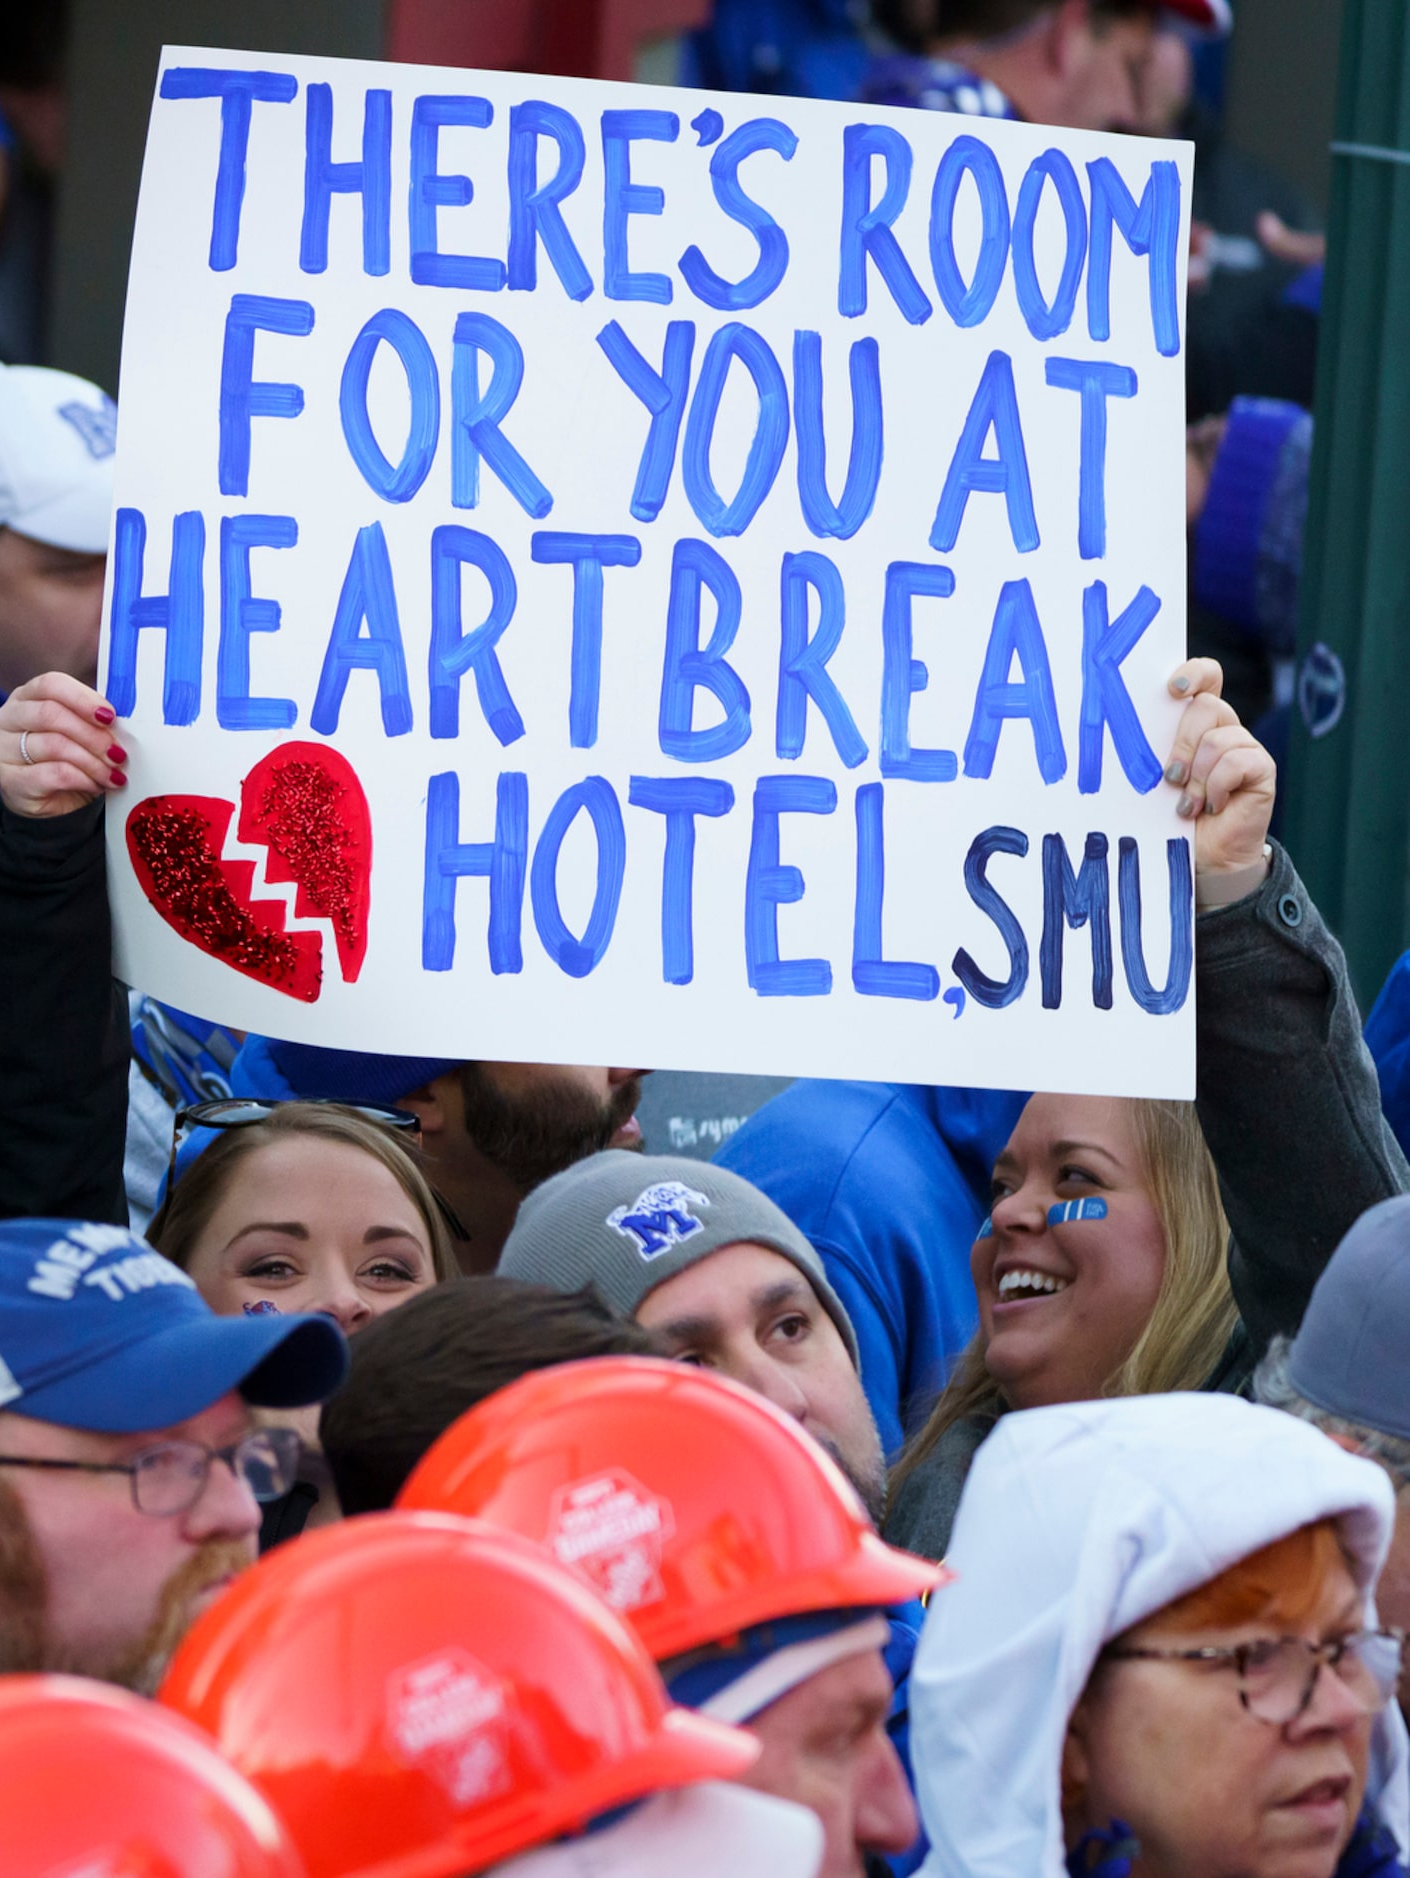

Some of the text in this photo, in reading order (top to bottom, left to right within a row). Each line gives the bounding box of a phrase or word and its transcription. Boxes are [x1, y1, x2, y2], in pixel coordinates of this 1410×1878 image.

[160, 66, 1182, 358] THERE'S ROOM
[217, 292, 1139, 561] FOR YOU AT
[104, 506, 1164, 796] HEARTBREAK
[422, 770, 1192, 1020] HOTEL, SMU
